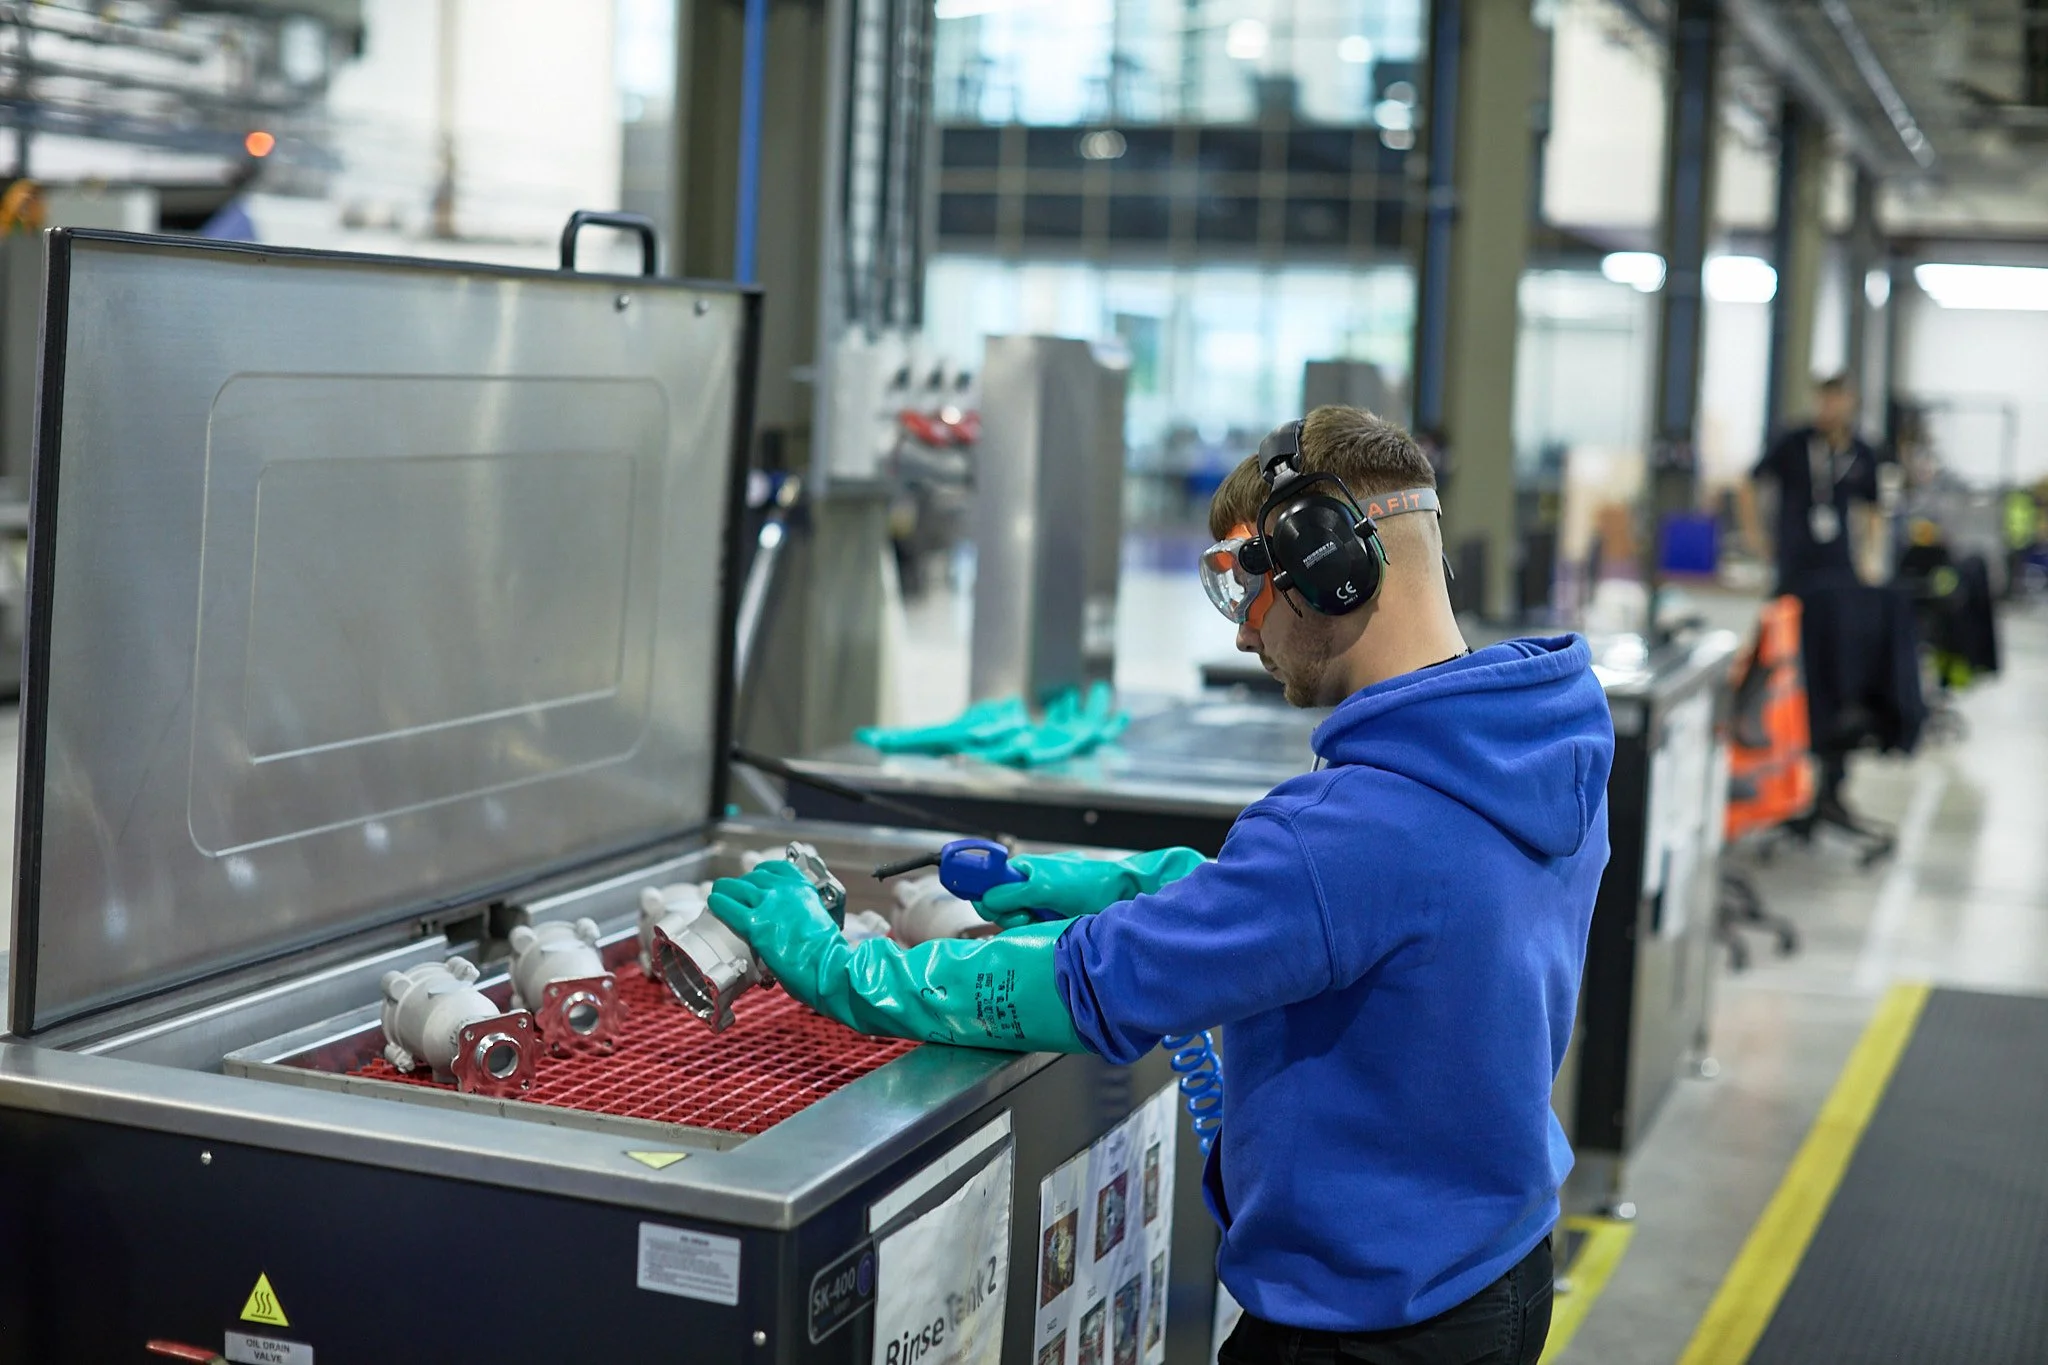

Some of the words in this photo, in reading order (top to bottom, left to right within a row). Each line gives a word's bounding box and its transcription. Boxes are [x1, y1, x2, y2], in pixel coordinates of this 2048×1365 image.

[813, 1266, 856, 1317] SK-400
[885, 1330, 945, 1365] Rinse
[987, 1255, 997, 1295] 2
[246, 1339, 260, 1349] OIL
[263, 1341, 290, 1353] DRAIN
[254, 1350, 283, 1364] VALVE
